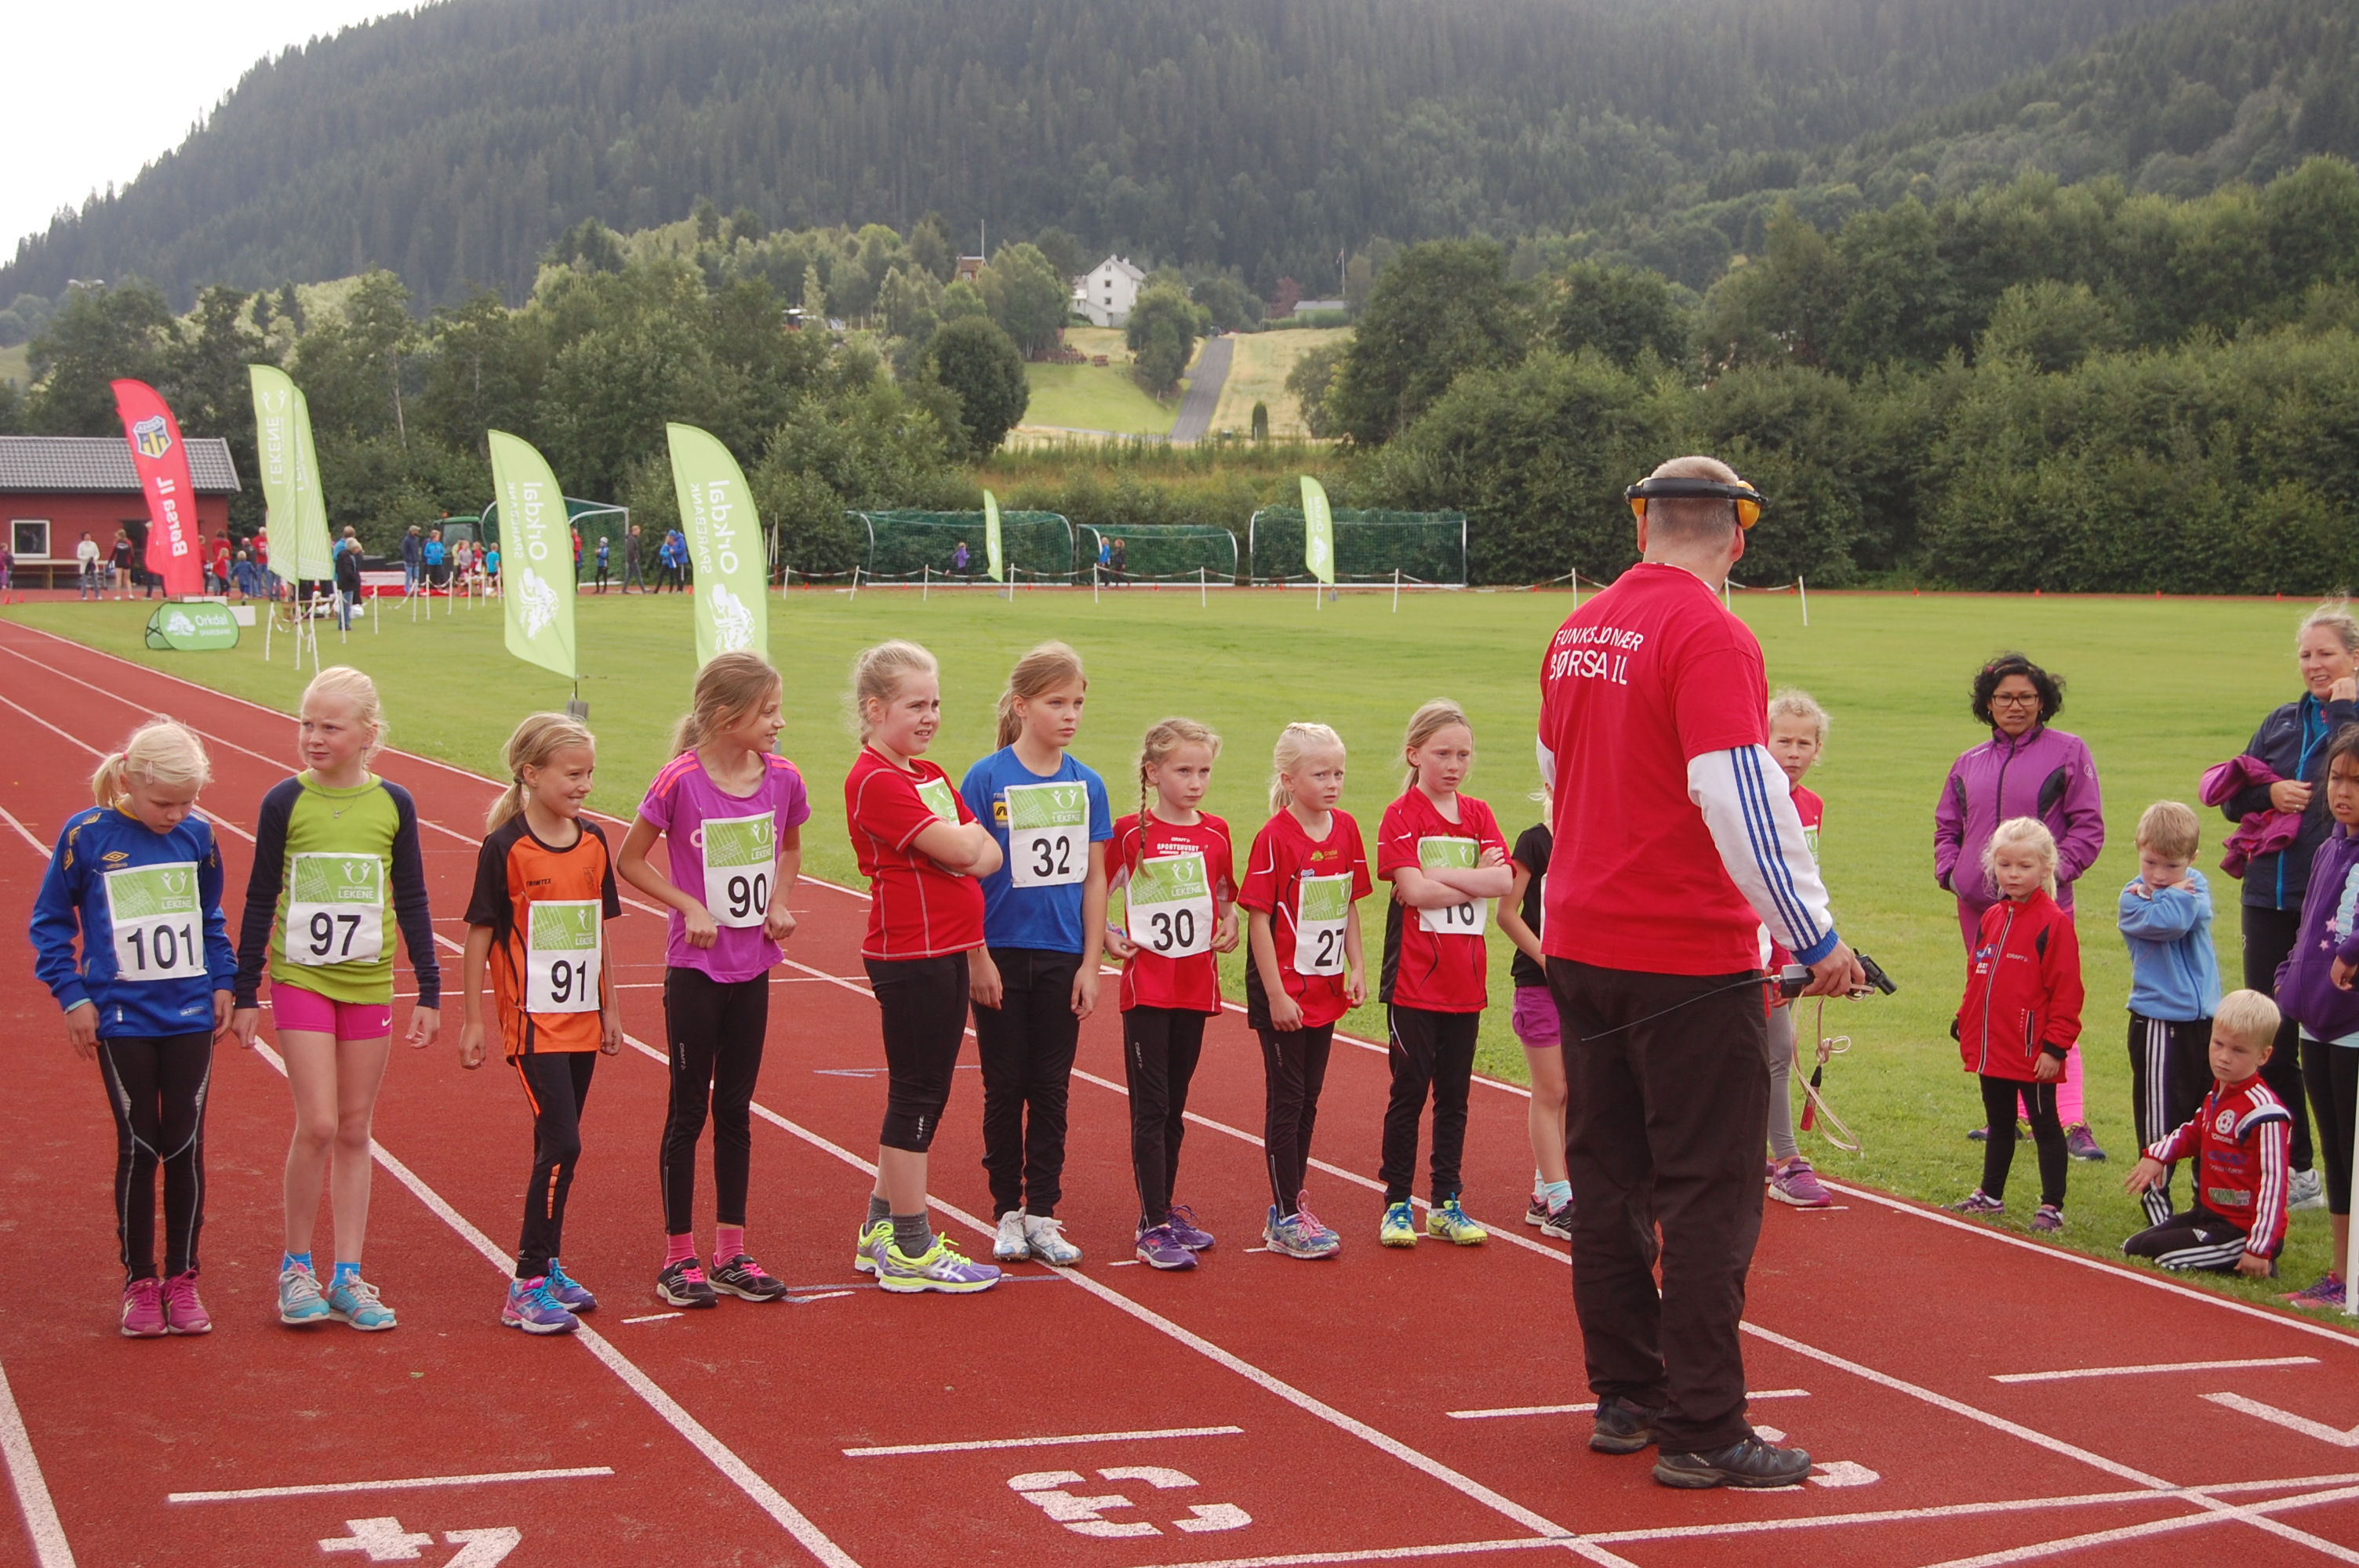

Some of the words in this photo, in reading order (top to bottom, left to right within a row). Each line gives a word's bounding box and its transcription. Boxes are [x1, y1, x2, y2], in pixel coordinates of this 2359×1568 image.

[195, 614, 228, 626] Orkdal
[1549, 649, 1607, 681] BØRSA
[1611, 655, 1627, 685] IL
[1052, 814, 1081, 823] LEKENE
[1032, 836, 1070, 877] 32
[162, 900, 193, 909] LEKENE
[338, 890, 374, 899] LEKENE
[728, 873, 767, 918] 90
[1171, 885, 1203, 897] LEKENE
[127, 924, 194, 970] 101
[310, 912, 361, 956] 97
[1151, 909, 1195, 951] 30
[1314, 927, 1344, 967] 27
[551, 960, 587, 1004] 91
